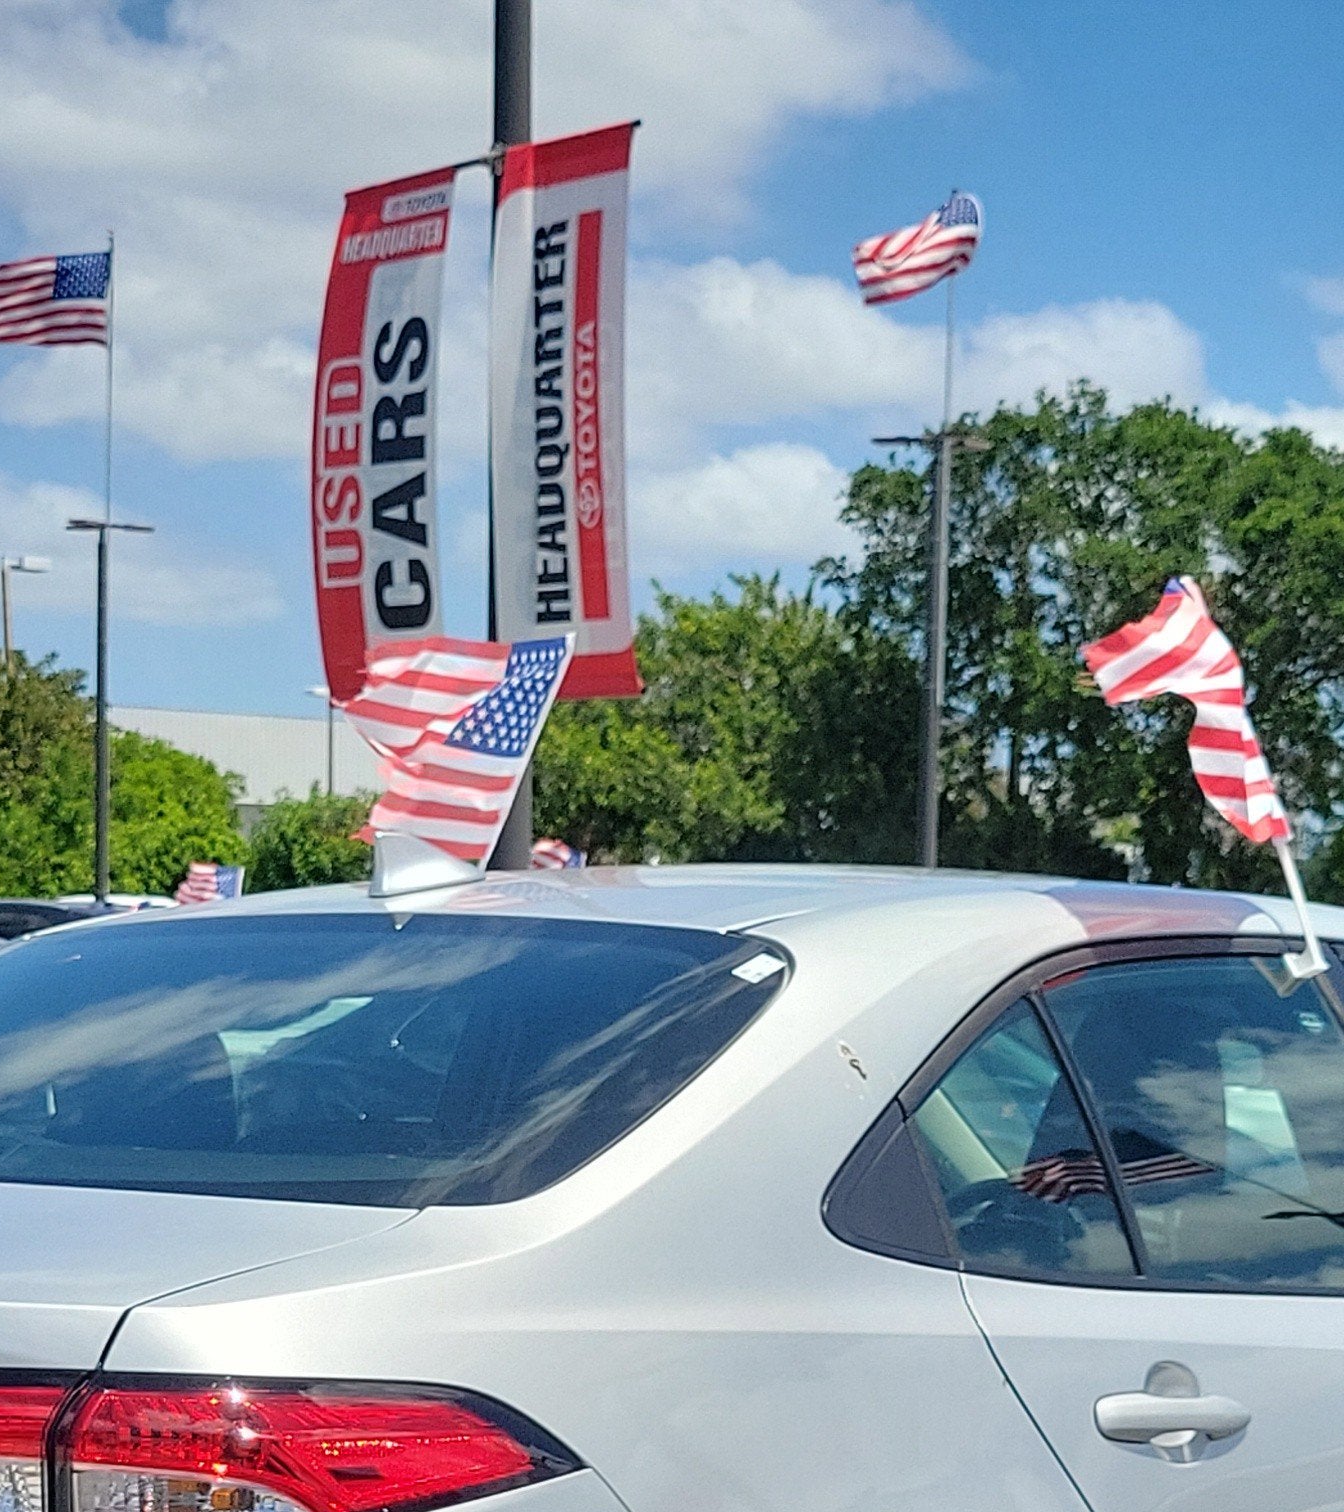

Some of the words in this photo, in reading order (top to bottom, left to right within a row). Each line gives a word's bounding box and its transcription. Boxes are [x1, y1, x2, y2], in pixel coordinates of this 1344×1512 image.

[321, 362, 363, 584] USED
[371, 315, 431, 630] CARS
[534, 220, 570, 622] HEADQUARTER
[574, 322, 597, 478] TOYOTA
